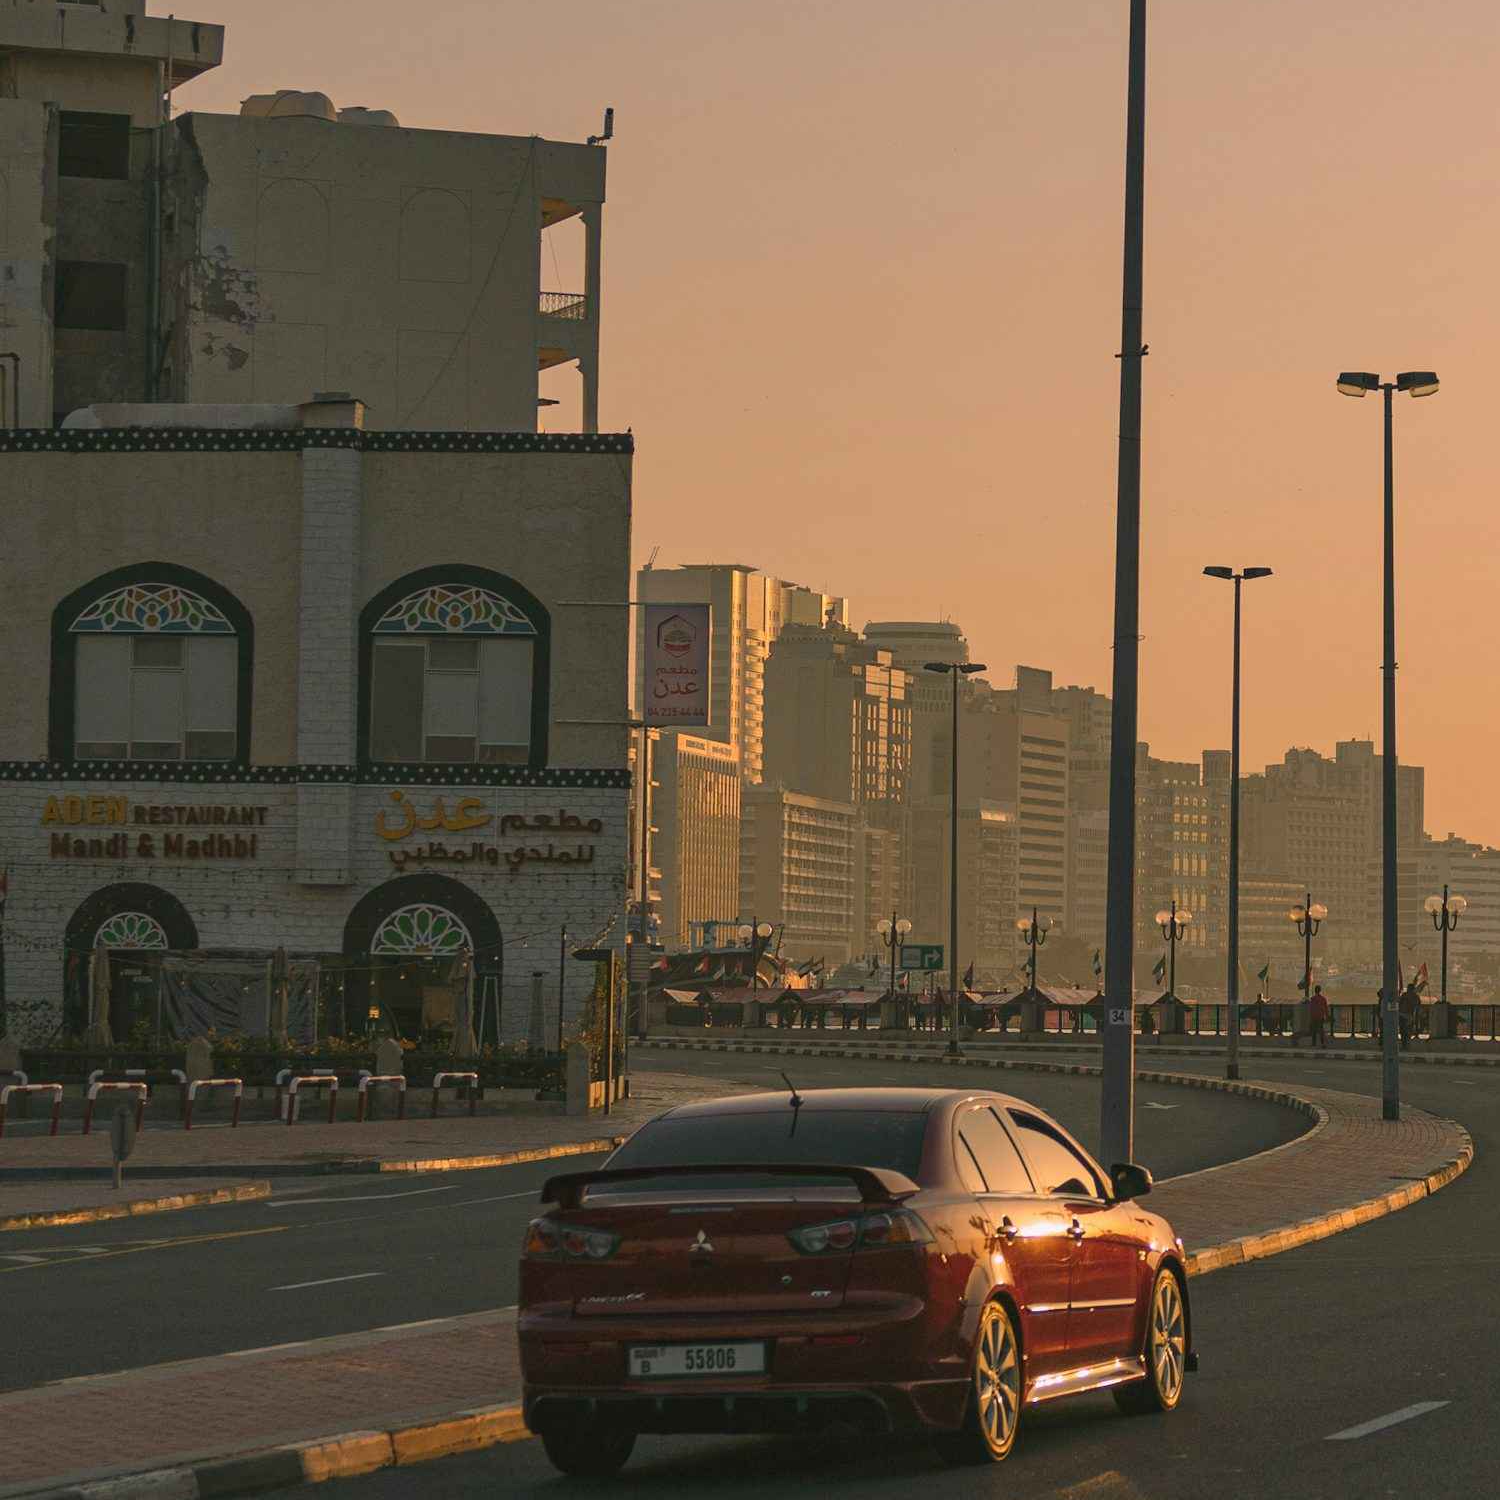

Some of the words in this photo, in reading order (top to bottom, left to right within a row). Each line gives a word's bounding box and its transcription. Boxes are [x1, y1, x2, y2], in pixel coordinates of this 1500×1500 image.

[656, 665, 697, 675] مطعم
[654, 679, 701, 698] عدن
[42, 795, 128, 826] ADEN
[134, 805, 268, 825] RESTAURANT
[374, 790, 494, 841] عدن
[499, 809, 603, 836] مطعم
[51, 833, 128, 859] Mandi
[136, 833, 155, 858] &
[163, 833, 257, 859] Madhbi
[1111, 1010, 1125, 1023] 34
[641, 1360, 651, 1373] B
